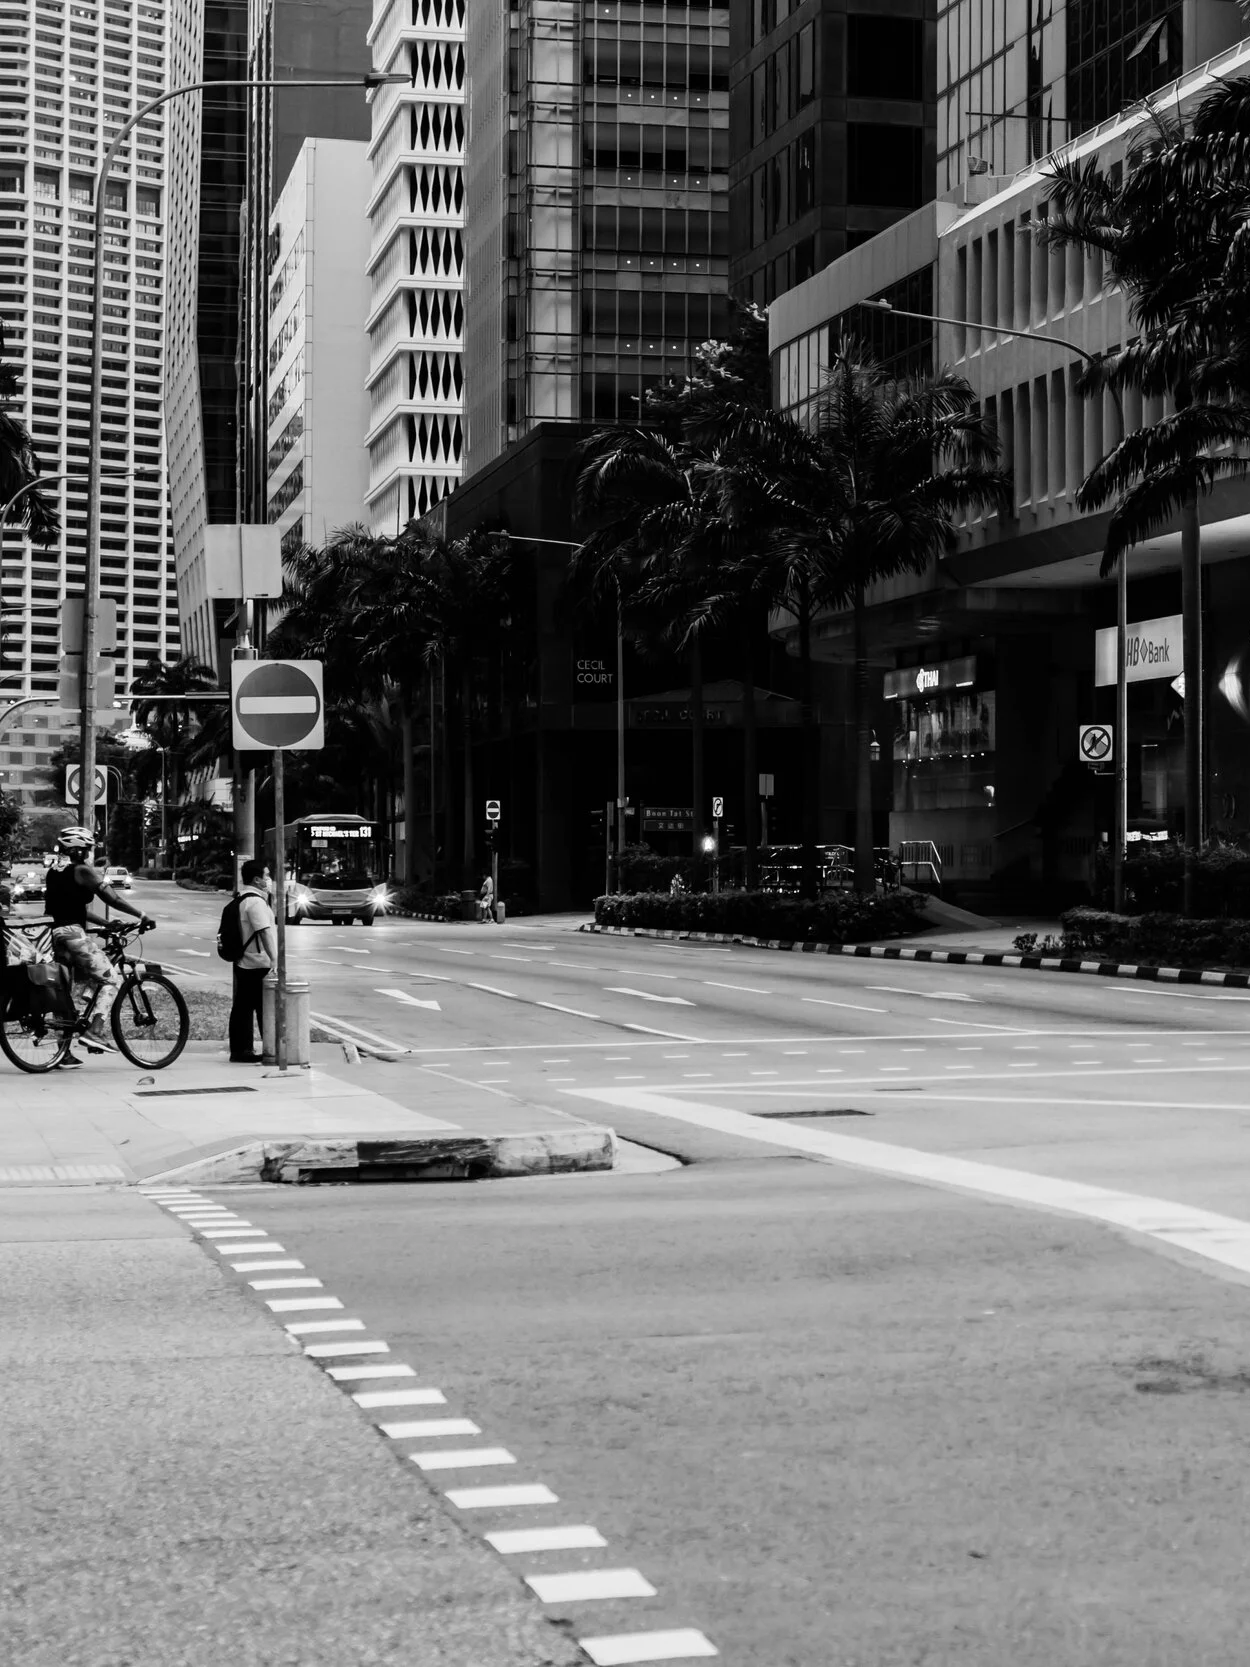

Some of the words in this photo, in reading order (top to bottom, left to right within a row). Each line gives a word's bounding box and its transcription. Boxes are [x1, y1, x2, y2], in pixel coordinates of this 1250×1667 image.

[1125, 636, 1140, 667] HB
[1148, 637, 1170, 664] Bank
[577, 660, 605, 670] CECIL
[577, 673, 614, 684] COURT
[646, 809, 667, 817] Boon
[670, 809, 682, 817] Tat
[685, 809, 694, 817] St
[360, 826, 372, 837] 131
